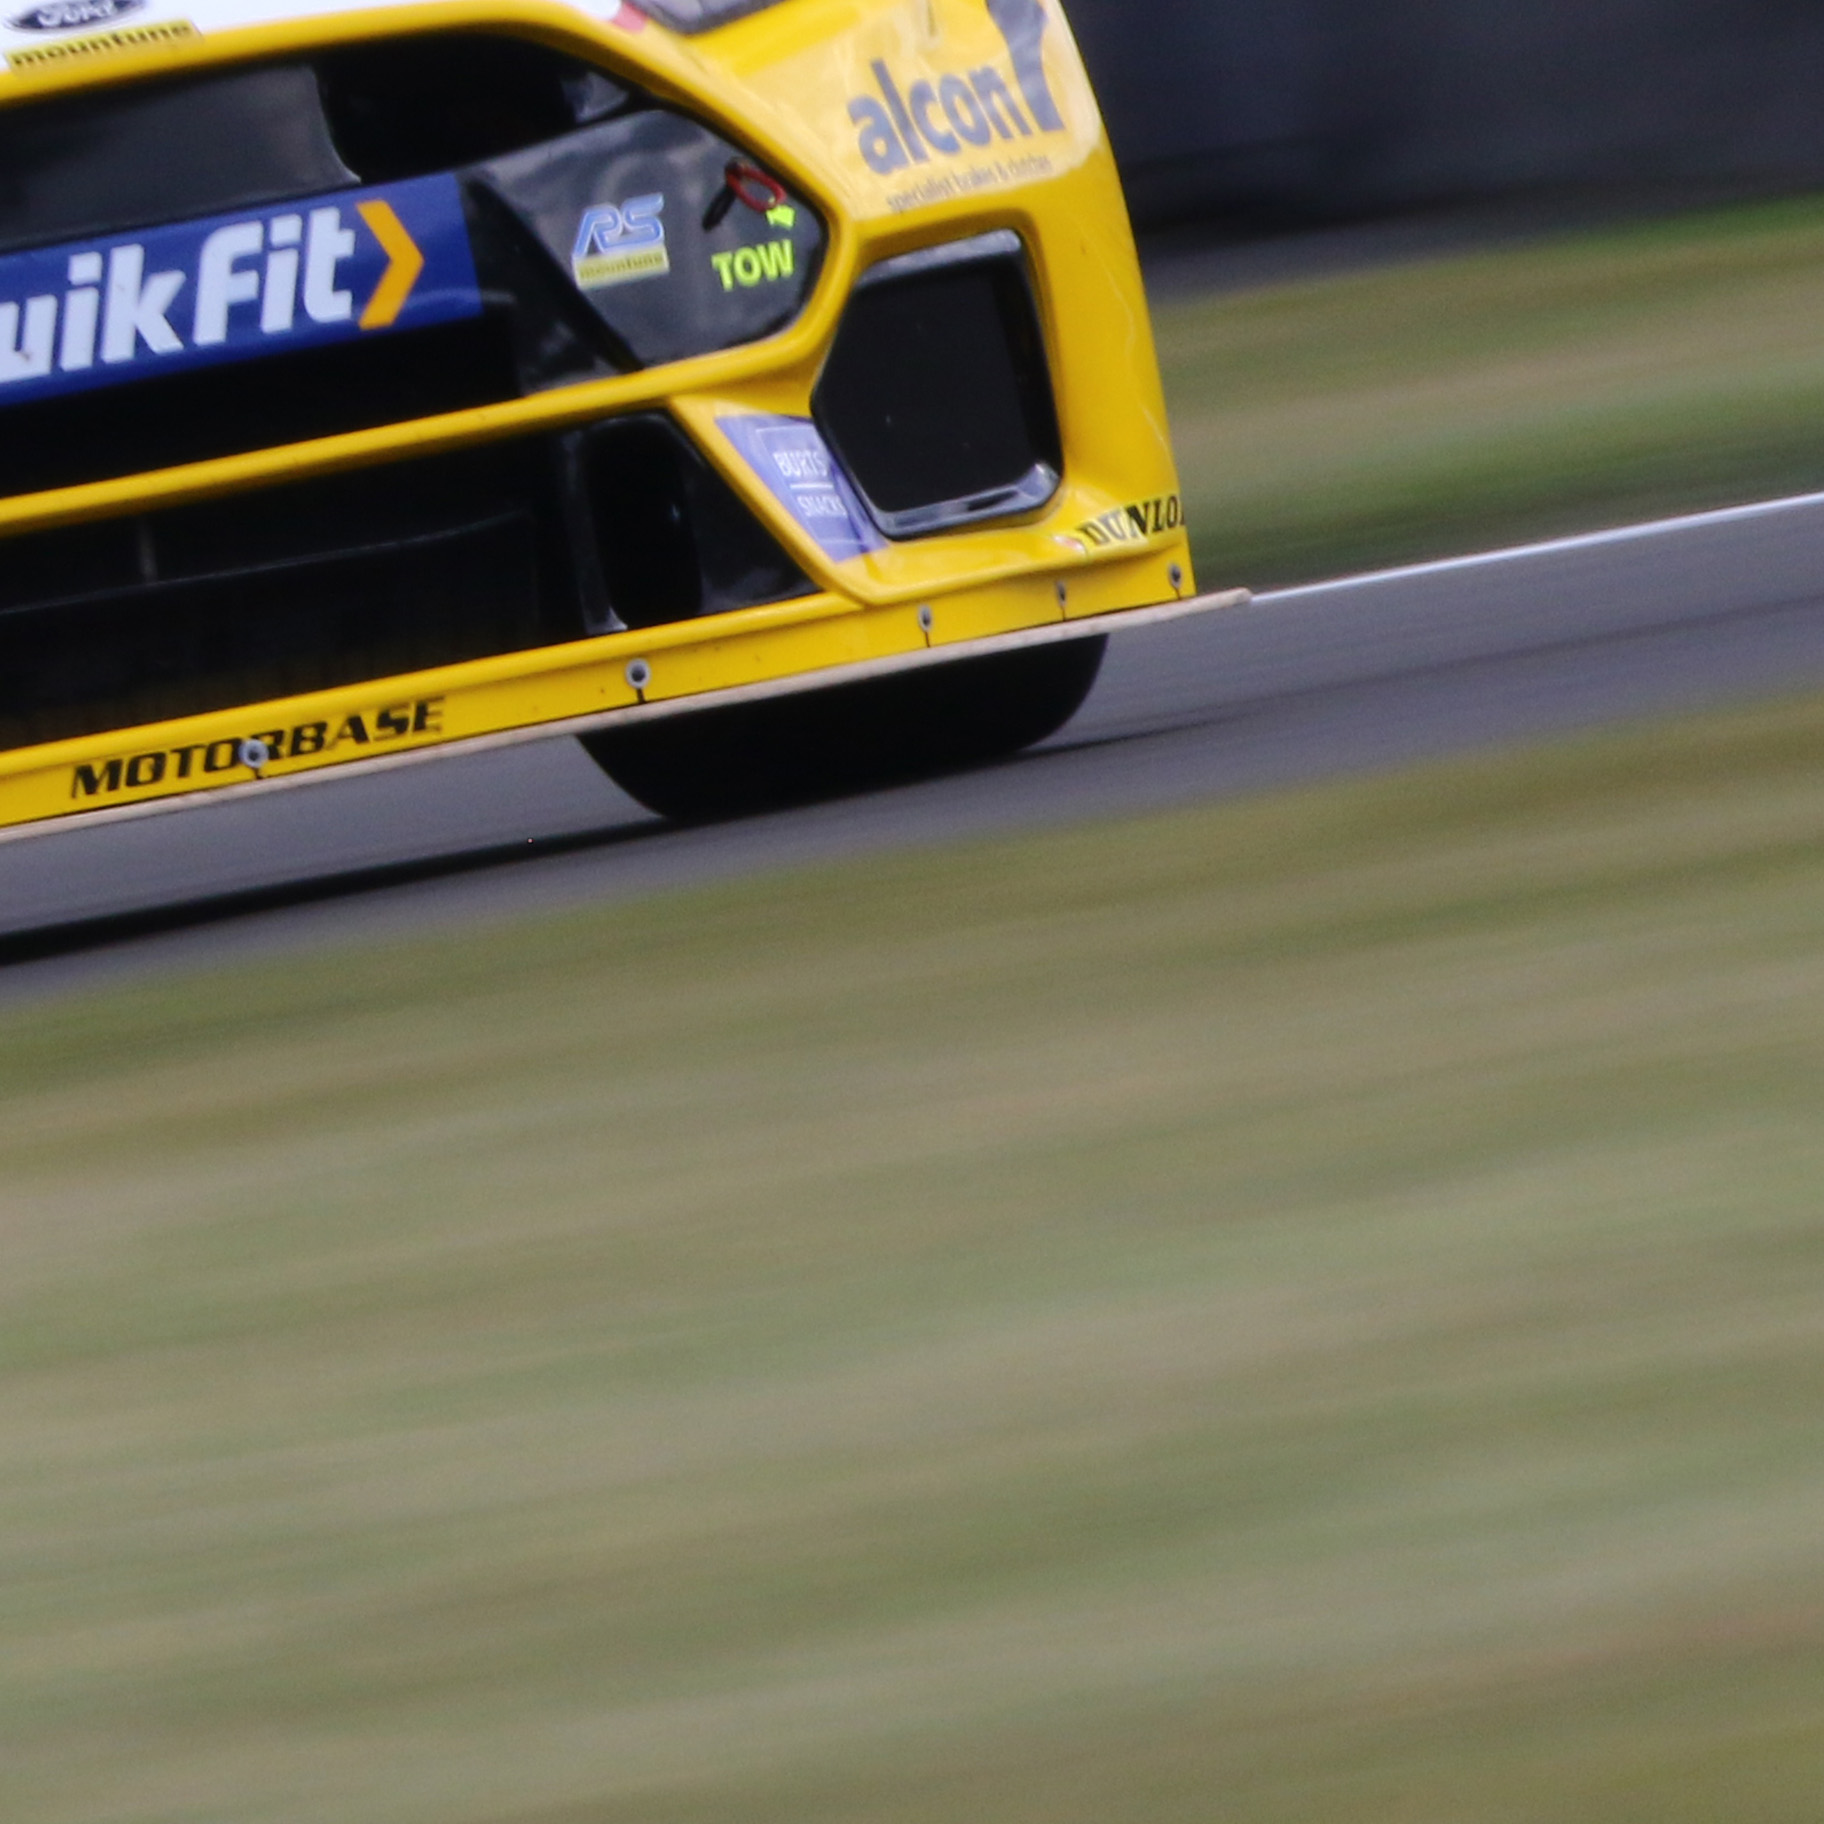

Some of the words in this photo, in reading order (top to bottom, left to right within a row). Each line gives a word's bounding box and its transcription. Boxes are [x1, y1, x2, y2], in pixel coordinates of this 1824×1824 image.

[848, 56, 1034, 174] alcon
[573, 193, 665, 257] RS
[711, 239, 794, 291] TOW
[773, 450, 829, 477] BURTS
[796, 495, 849, 518] SNACKS
[1076, 494, 1184, 546] DUNLO
[71, 695, 446, 799] MOTORBASE
